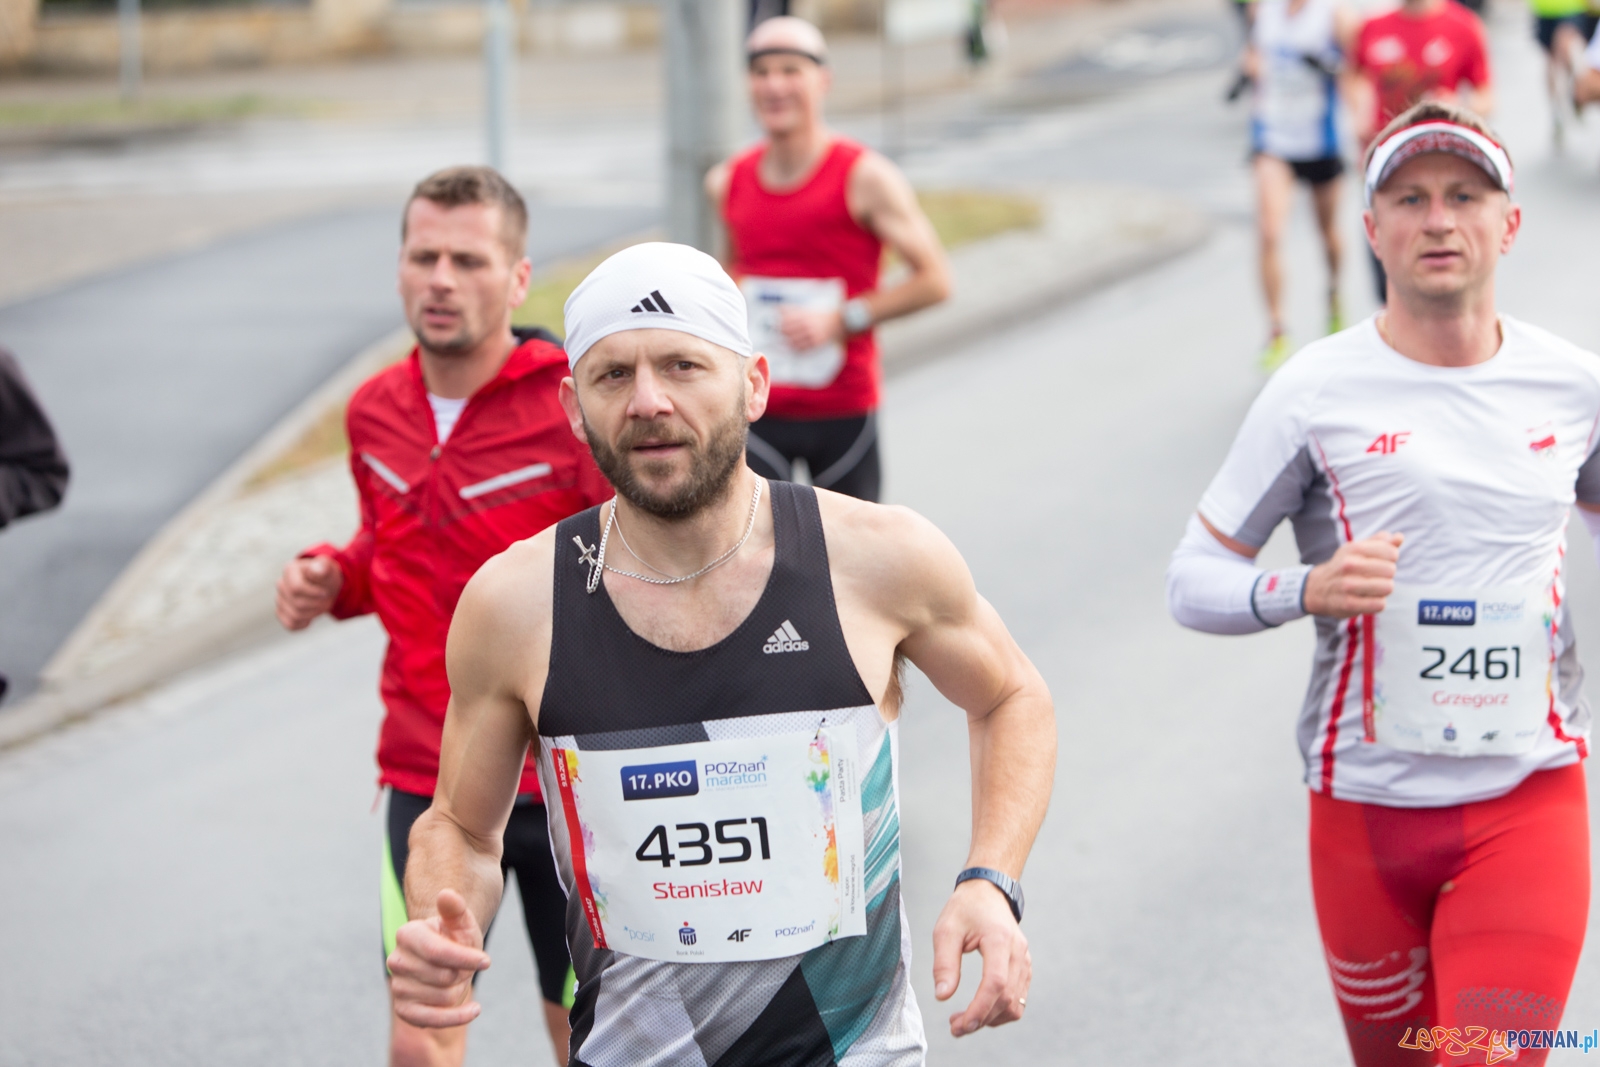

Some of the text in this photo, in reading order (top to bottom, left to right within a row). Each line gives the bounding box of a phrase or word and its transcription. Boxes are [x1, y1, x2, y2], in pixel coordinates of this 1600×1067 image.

[762, 639, 810, 655] adidas
[1420, 646, 1520, 680] 2461
[1432, 690, 1509, 710] Grzegorz
[706, 772, 767, 787] maraton
[635, 816, 771, 868] 4351
[652, 878, 763, 900] Stanisław
